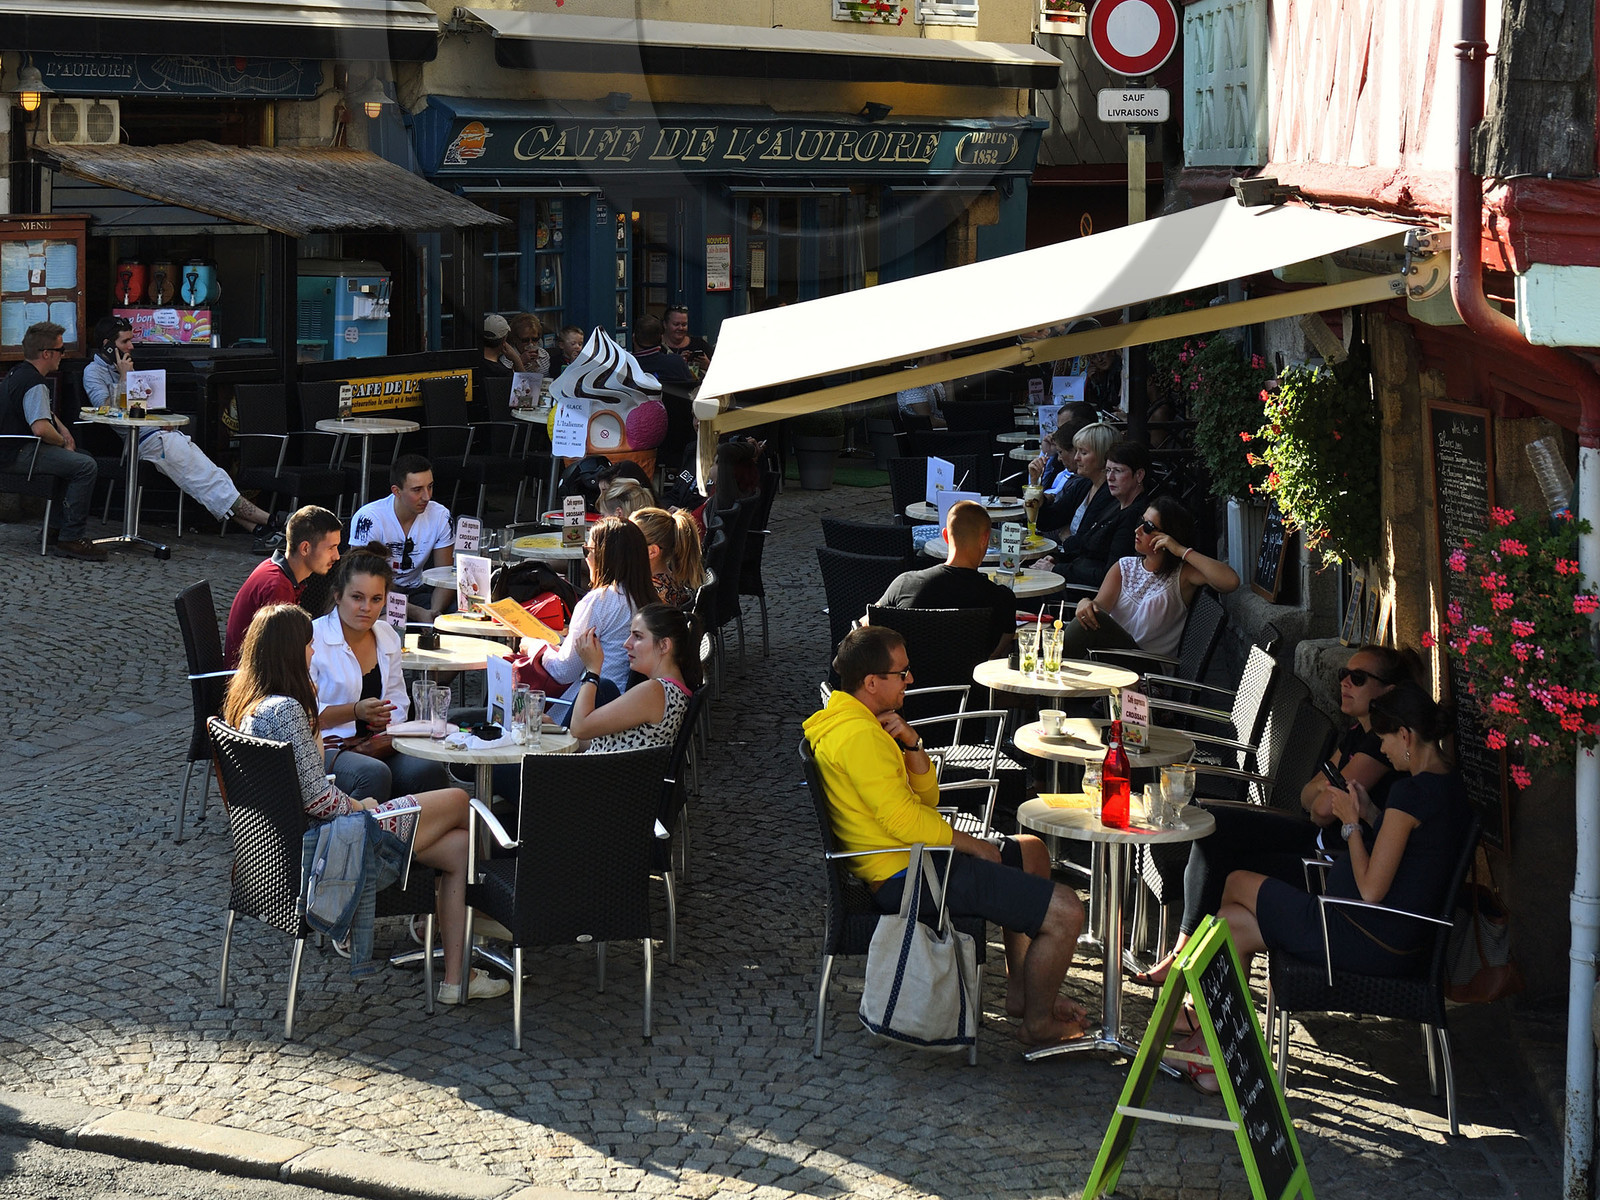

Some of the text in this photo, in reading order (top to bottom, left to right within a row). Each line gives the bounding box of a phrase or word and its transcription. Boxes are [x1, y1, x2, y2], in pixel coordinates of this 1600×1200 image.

[46, 62, 133, 78] L'AURORE
[1122, 93, 1145, 102] SAUF
[1107, 108, 1159, 118] LIVRAISONS
[513, 125, 646, 162] CAFE
[648, 126, 719, 163] DE
[970, 131, 1008, 145] DEPUIS
[973, 149, 999, 166] 1852
[21, 221, 51, 230] MENU
[351, 381, 382, 399] CAFE
[383, 379, 403, 396] DE
[1125, 710, 1147, 722] CROISSANT
